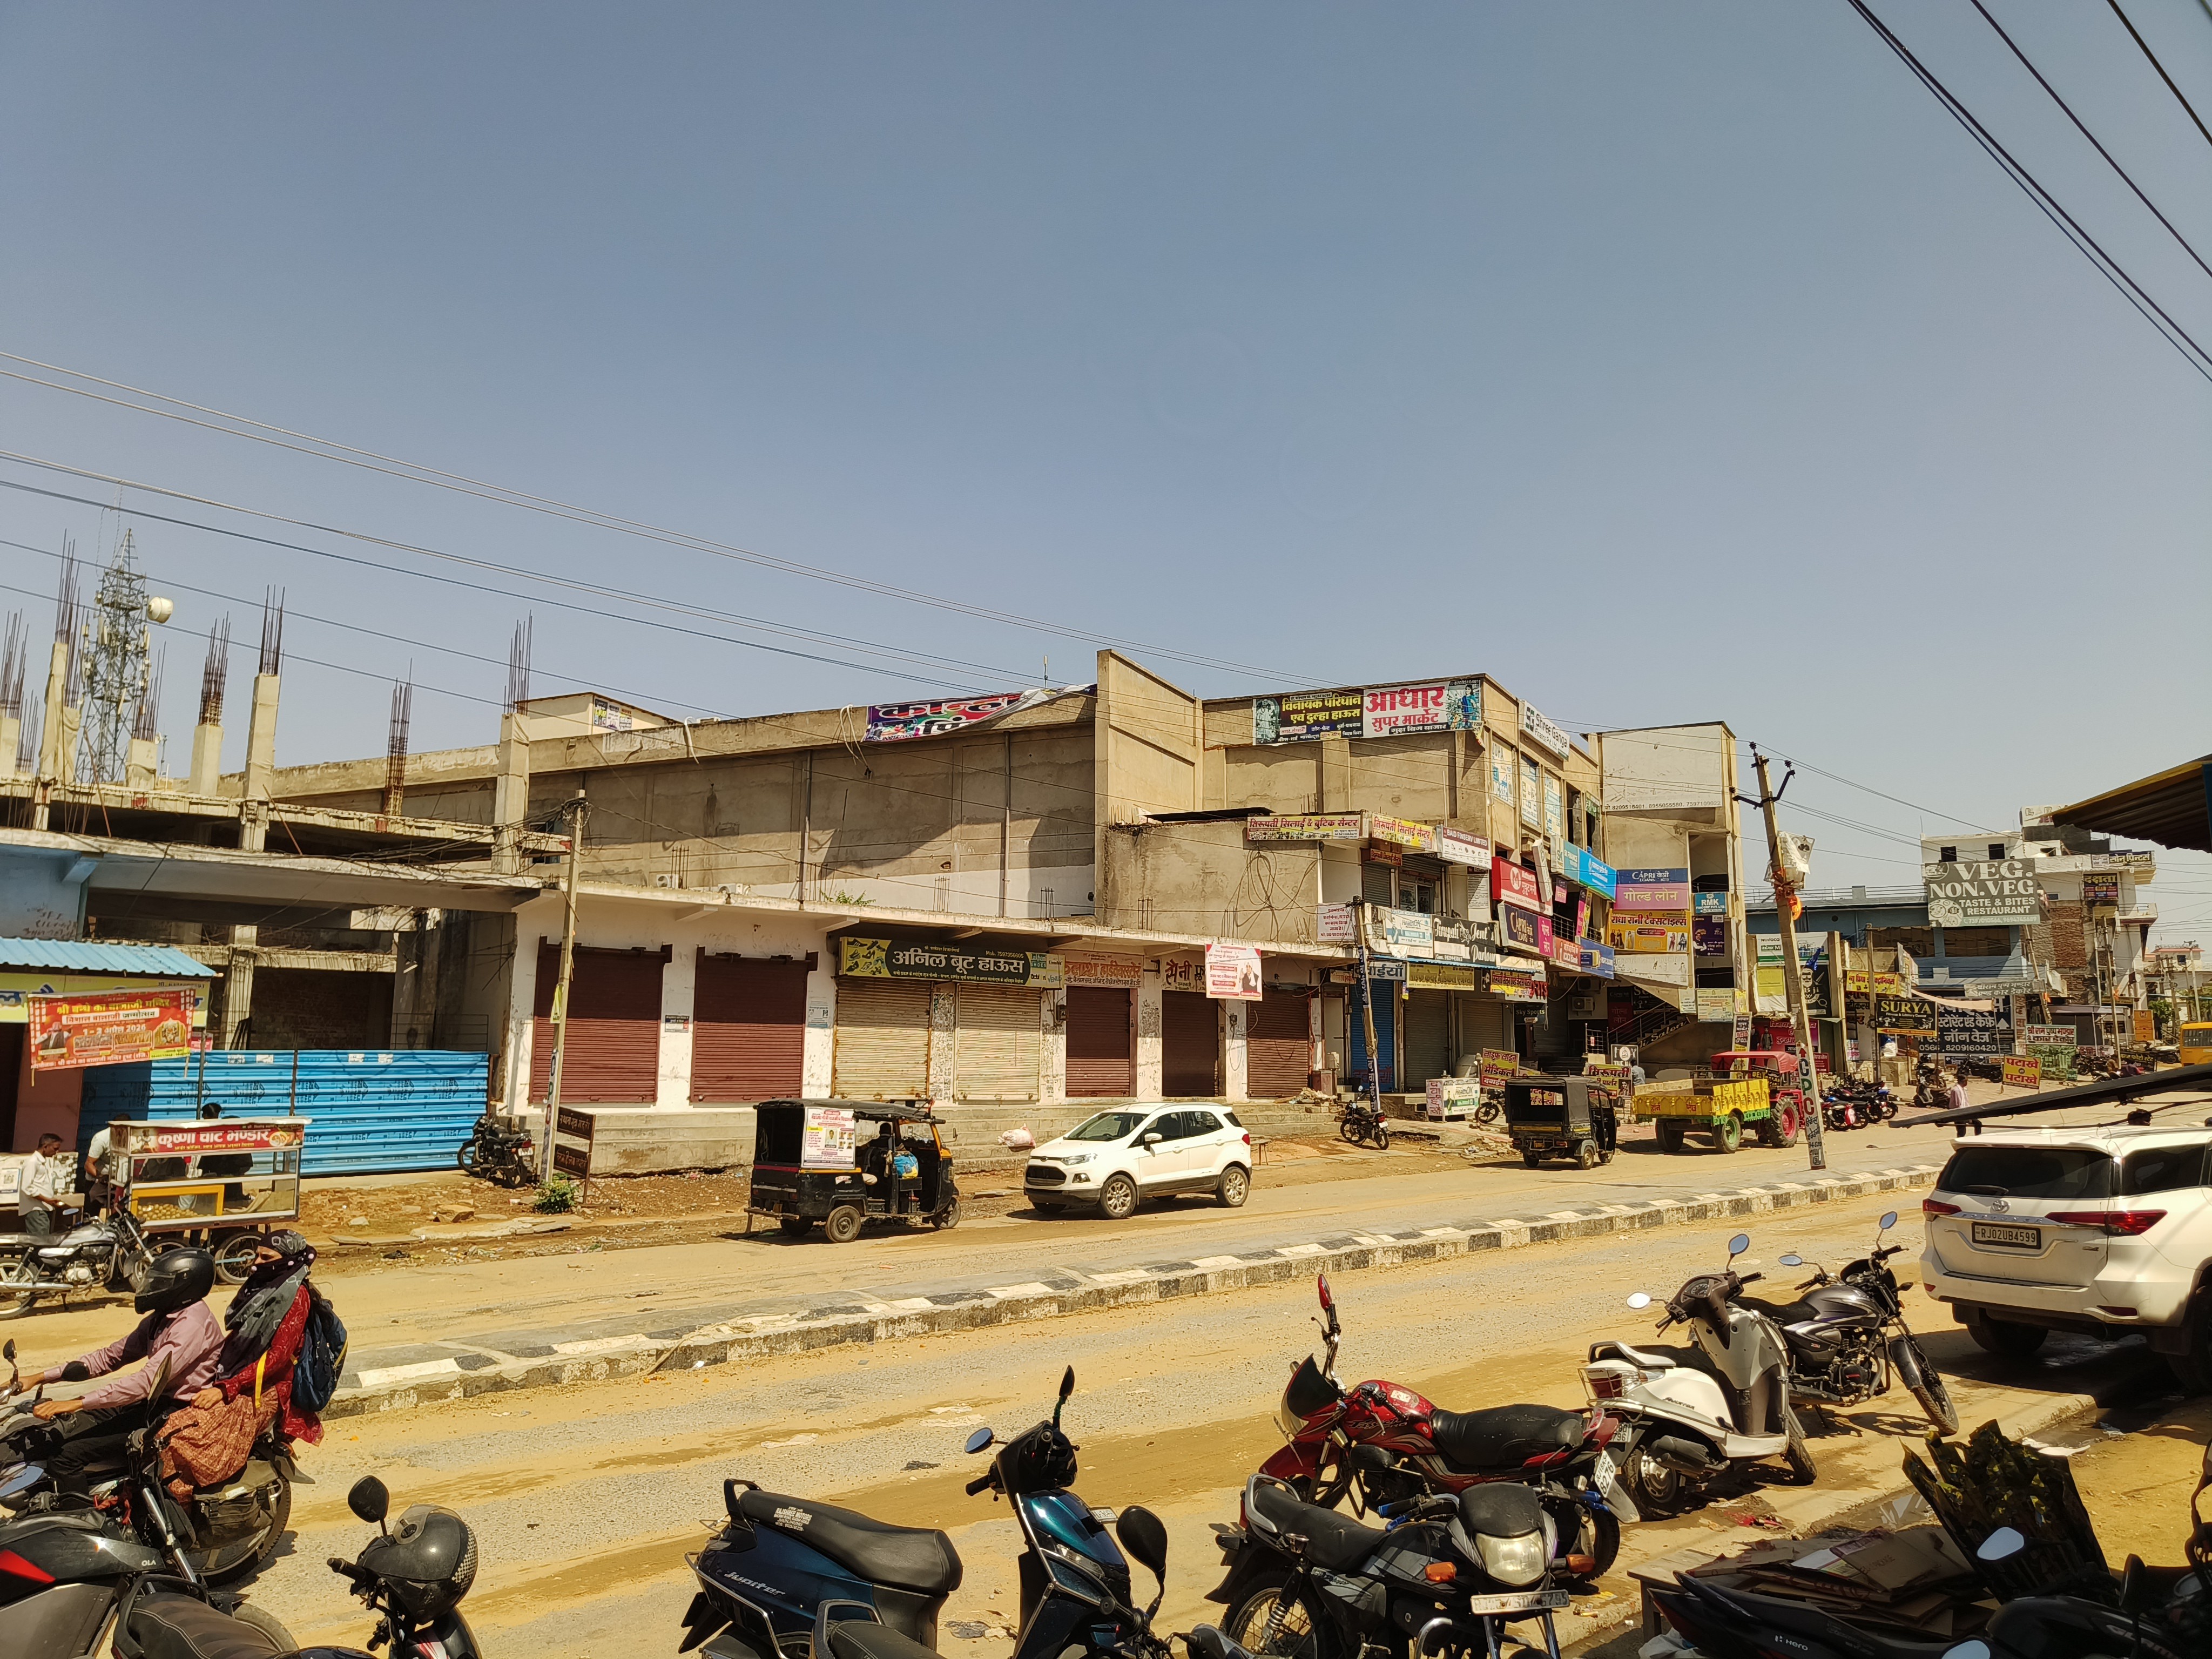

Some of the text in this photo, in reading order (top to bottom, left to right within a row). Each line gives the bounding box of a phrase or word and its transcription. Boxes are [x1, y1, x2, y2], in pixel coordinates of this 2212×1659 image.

[1282, 693, 1361, 711] विनायक परिधान
[1366, 686, 1445, 713] आधार
[1290, 712, 1304, 723] एवं
[1331, 709, 1360, 721] हाऊस
[1372, 709, 1439, 733] सुपर मार्केट
[1536, 713, 1552, 736] Shree
[1552, 726, 1567, 748] Ganga
[1280, 817, 1305, 832] सिलाई
[1457, 831, 1473, 843] FINSERV
[1473, 837, 1487, 847] LIMITED
[1632, 871, 1655, 880] CAPRI
[1623, 887, 1678, 902] गोल्ड लोन
[1959, 899, 1992, 907] TASTE
[2005, 897, 2035, 906] BITES
[1967, 906, 2031, 915] RESTAURANT
[1611, 915, 1626, 924] राधा
[1628, 914, 1643, 925] रानी
[892, 947, 1024, 974] अनिल बूट हाऊस
[1881, 1000, 1932, 1014] SURYA
[1651, 1021, 1688, 1041] Salon
[1944, 1028, 1991, 1043] नॉन वेज
[2006, 1057, 2039, 1069] पटाखे
[2005, 1073, 2038, 1084] पटाखे
[158, 1131, 197, 1149] कृष्णा
[227, 1129, 272, 1142] भण्डार
[1981, 1228, 2036, 1243] RJ02UB4599
[1599, 1461, 1614, 1495] 8276
[724, 1572, 786, 1596] Jupiter
[1785, 1638, 1809, 1651] Hero
